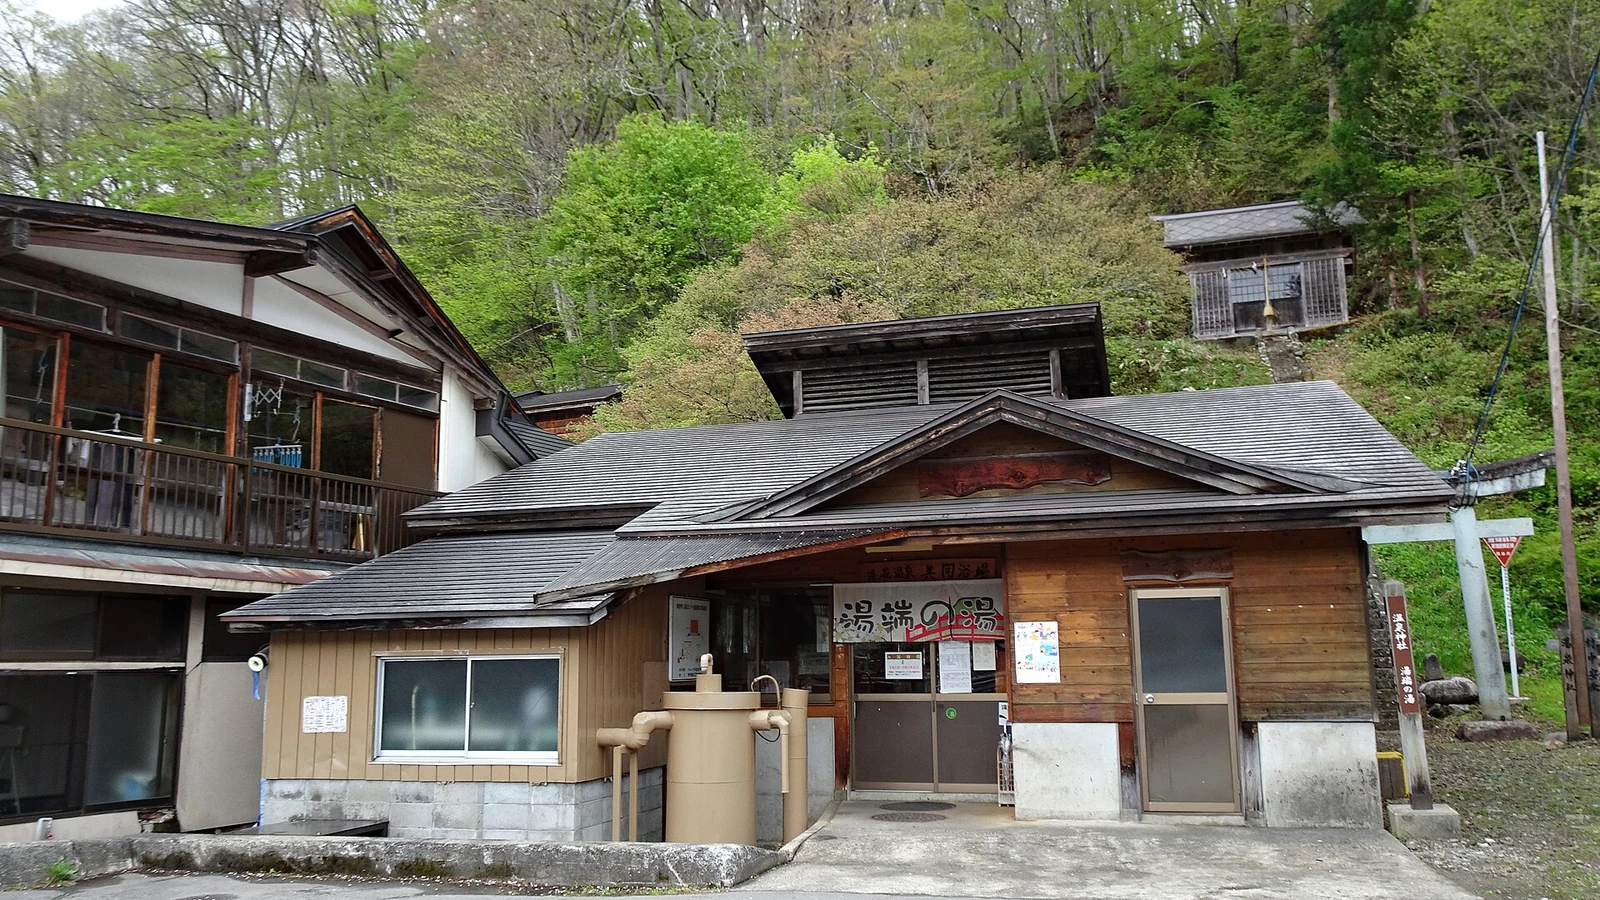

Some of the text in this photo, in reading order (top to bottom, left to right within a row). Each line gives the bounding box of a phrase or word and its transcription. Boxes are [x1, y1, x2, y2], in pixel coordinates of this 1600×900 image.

[841, 598, 997, 634] 湯端の湯
[1392, 613, 1418, 704] 温泉神社 湯端の湯
